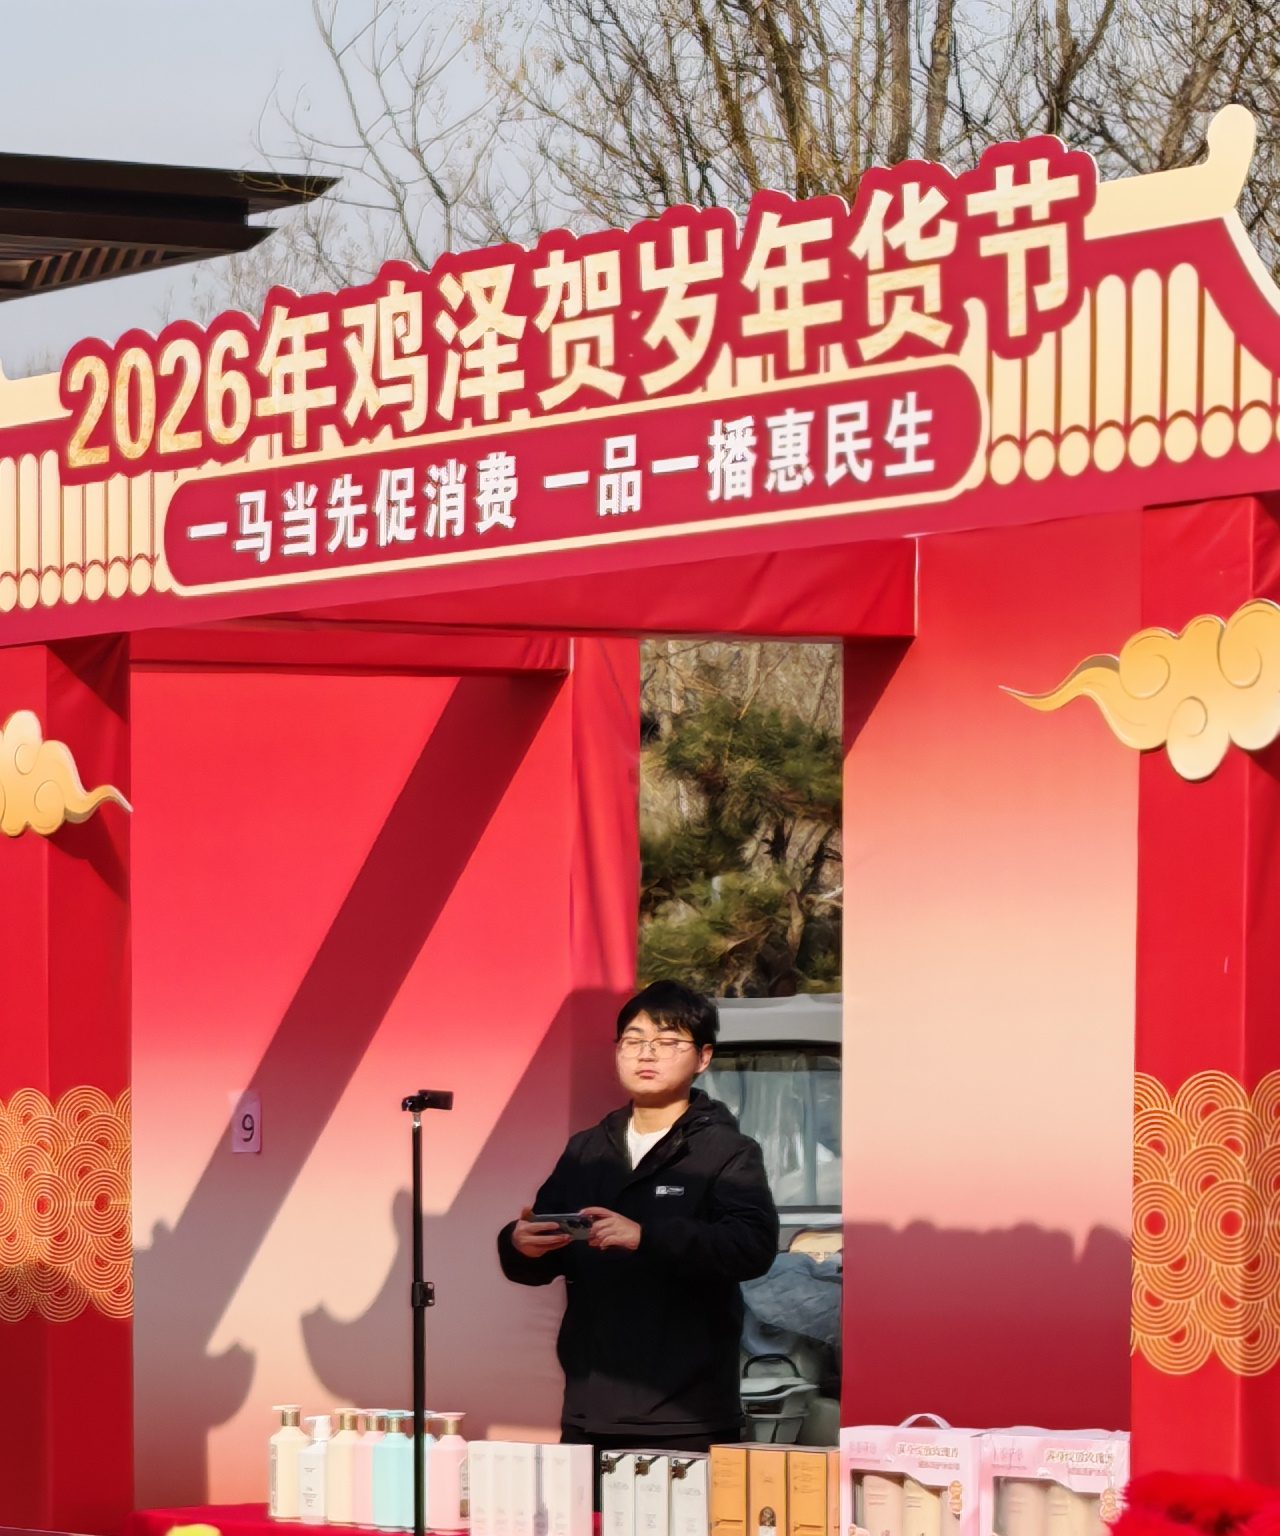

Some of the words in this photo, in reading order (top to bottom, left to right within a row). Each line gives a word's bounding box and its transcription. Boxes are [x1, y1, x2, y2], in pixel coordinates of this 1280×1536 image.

[67, 158, 1079, 468] 2026年鸡泽贺岁年货节
[187, 450, 519, 563] 一马当先促消费
[543, 390, 935, 517] 一品一播惠民生
[241, 1113, 256, 1143] 9
